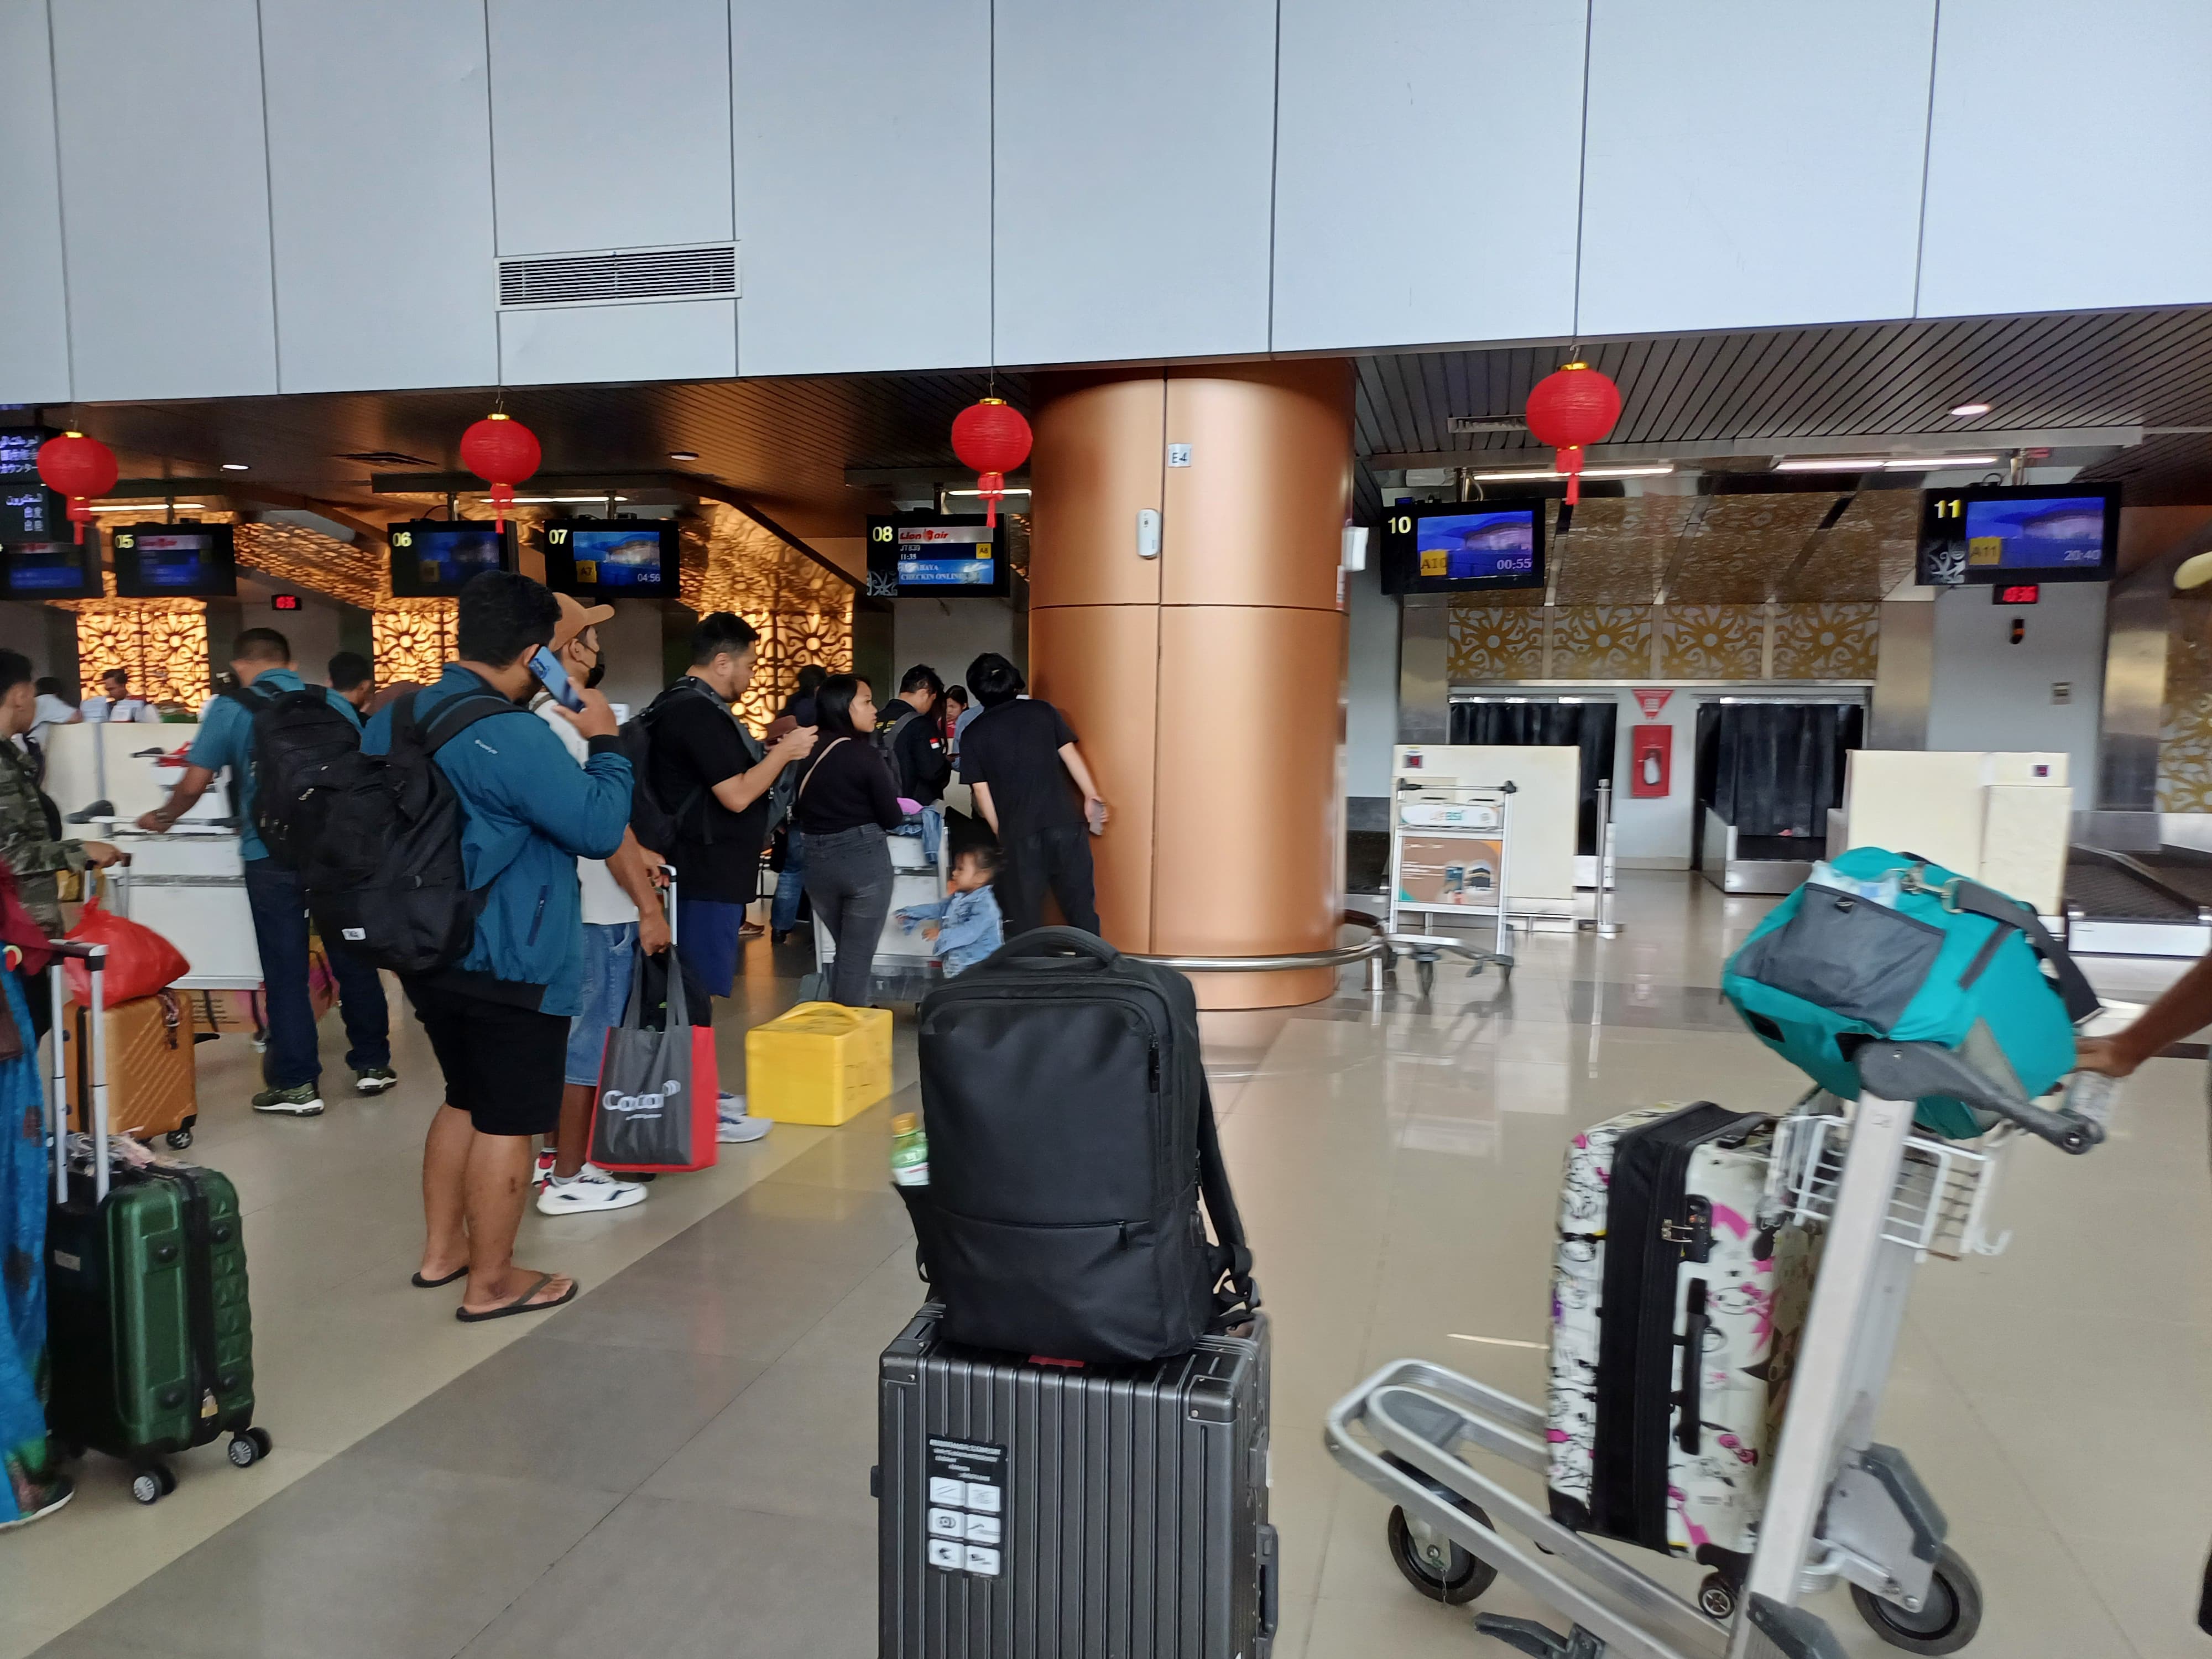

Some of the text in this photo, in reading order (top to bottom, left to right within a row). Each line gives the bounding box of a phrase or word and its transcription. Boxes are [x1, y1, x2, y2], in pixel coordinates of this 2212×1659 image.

[1934, 499, 1961, 518] 11
[1388, 516, 1411, 534] 10
[393, 532, 412, 547] 06
[549, 529, 567, 545] 07
[873, 526, 893, 542] 08
[1496, 559, 1532, 570] 00:55
[638, 573, 661, 582] 04:56
